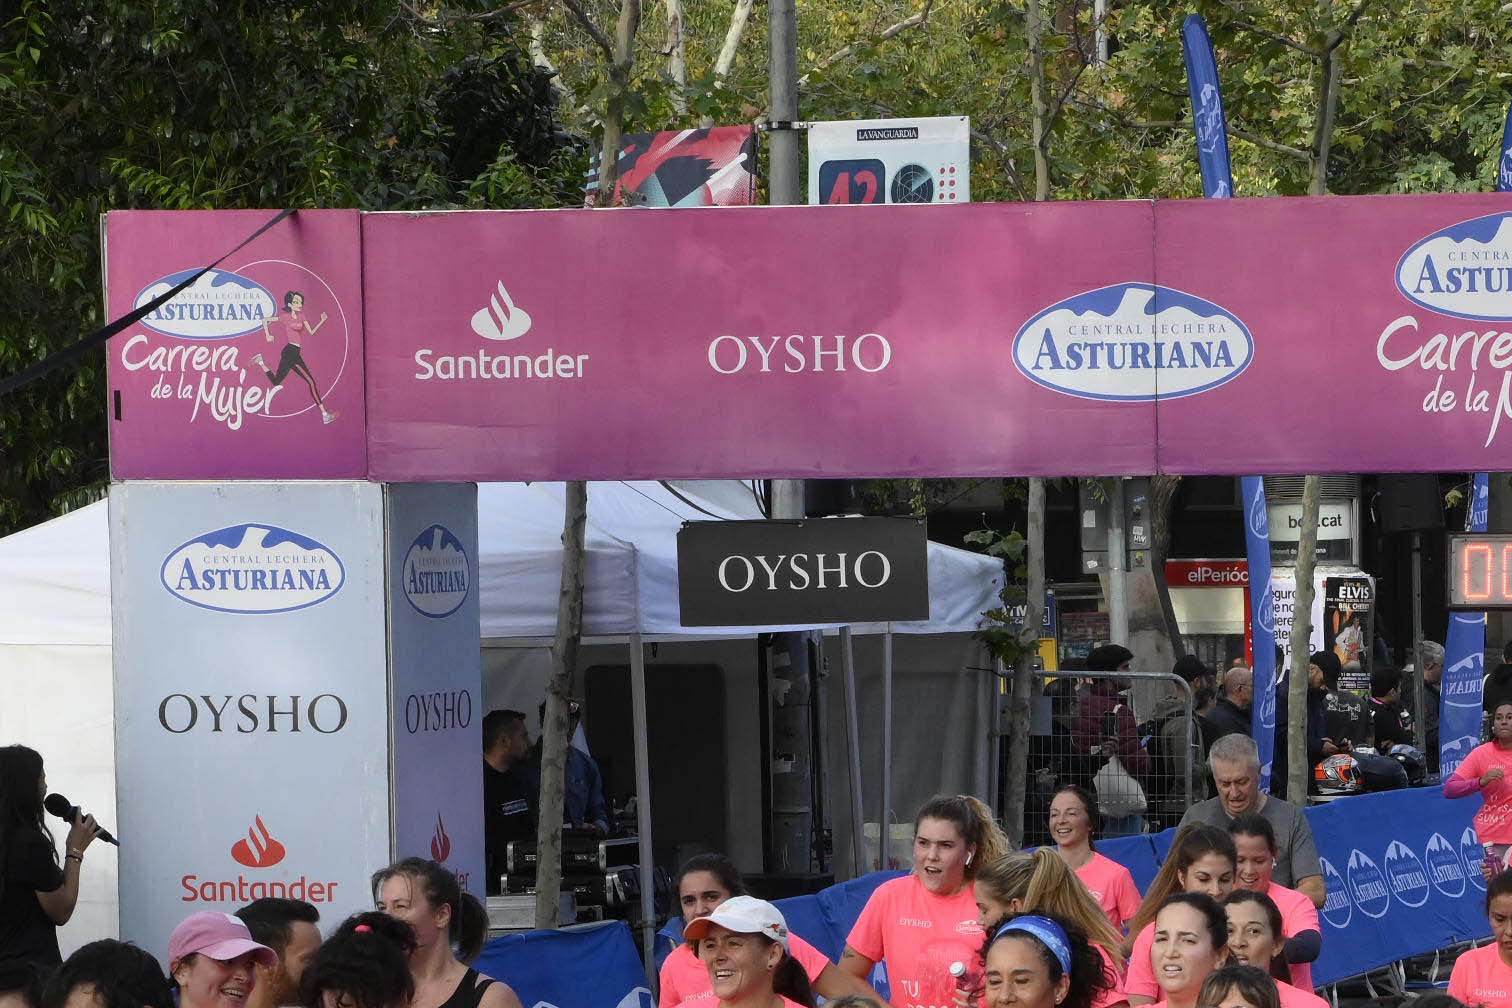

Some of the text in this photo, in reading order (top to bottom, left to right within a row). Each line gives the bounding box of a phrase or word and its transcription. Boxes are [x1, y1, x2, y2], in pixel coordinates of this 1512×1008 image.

[869, 129, 917, 139] VANGUARDIA
[145, 294, 266, 321] ASTURIANA
[1069, 323, 1227, 335] CENTRAL LECHERA
[120, 334, 240, 372] Carrera
[414, 348, 590, 379] Santander
[707, 333, 892, 374] OYSHO
[1033, 328, 1235, 370] ASTURIANA
[151, 369, 283, 430] de la Mujer
[1422, 374, 1456, 413] de
[1465, 374, 1490, 413] la
[176, 557, 333, 593] ASTURIANA
[203, 554, 326, 564] CENTRAL LECHERA
[408, 559, 467, 595] ASTURIANA
[719, 550, 892, 592] OYSHO
[1339, 586, 1370, 599] ELVIS
[157, 694, 349, 735] OYSHO
[405, 690, 472, 734] OYSHO
[181, 873, 338, 902] Santander
[901, 980, 920, 997] TU
